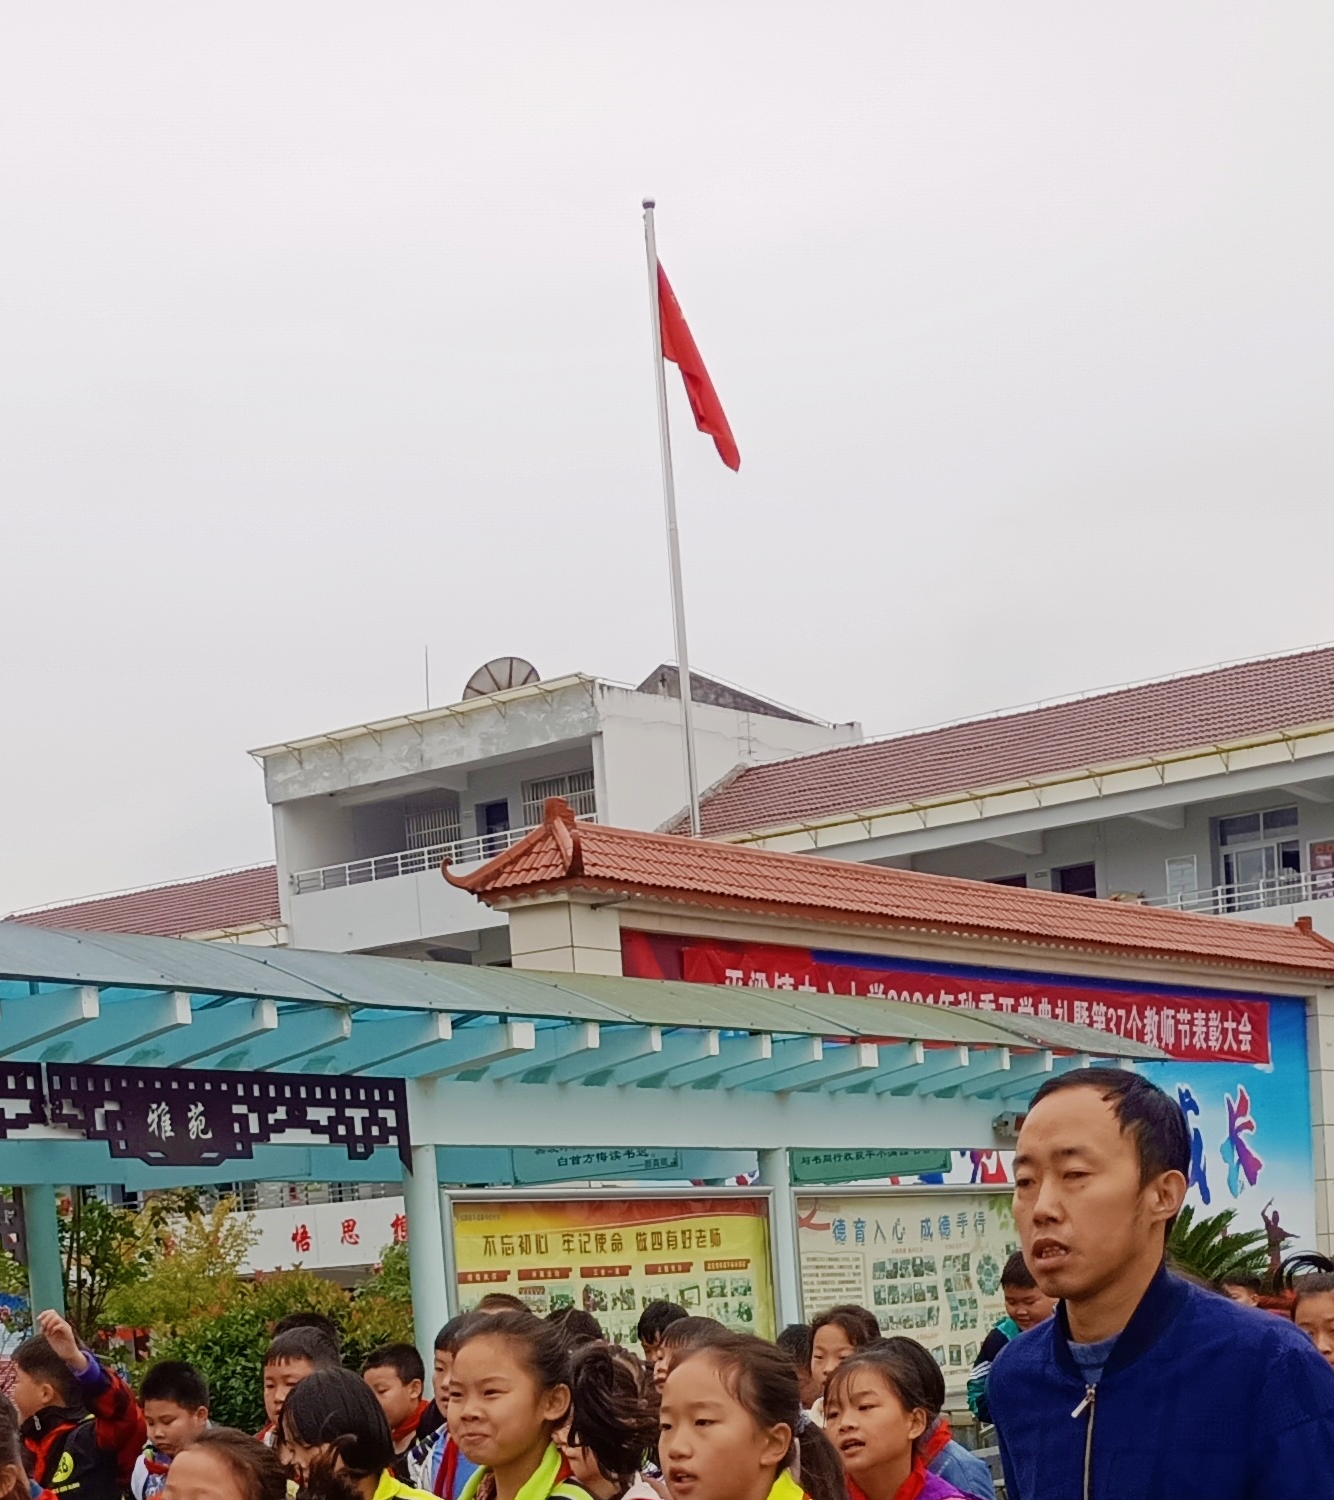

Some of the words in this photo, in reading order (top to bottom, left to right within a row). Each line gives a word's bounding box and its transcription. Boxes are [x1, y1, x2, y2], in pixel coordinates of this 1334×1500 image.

[482, 1234, 549, 1257] 不忘初心
[561, 1231, 624, 1255] 牢记使命
[635, 1227, 723, 1252] 做四有好老师
[832, 1217, 906, 1245] 德育入心
